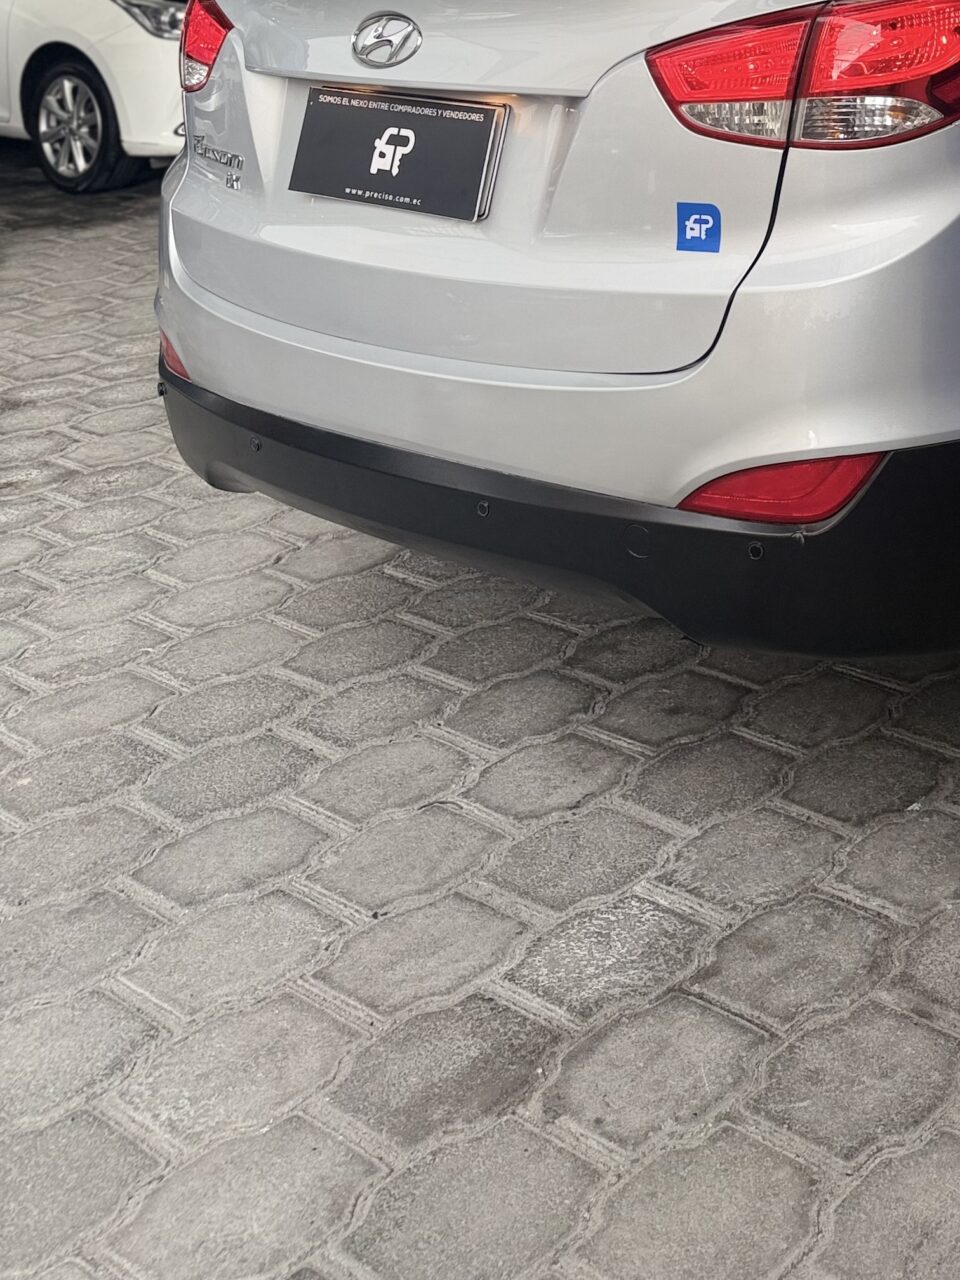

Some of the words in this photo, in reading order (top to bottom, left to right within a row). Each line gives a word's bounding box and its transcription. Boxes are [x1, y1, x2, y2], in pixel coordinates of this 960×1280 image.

[319, 94, 342, 106] SOMOS
[342, 97, 350, 106] EL
[351, 99, 368, 108] NEXO
[368, 101, 389, 111] ENTRE
[389, 104, 437, 117] COMPRADORES
[442, 110, 484, 122] VENDEDORES
[345, 187, 421, 206] www.preciso.com.ec
